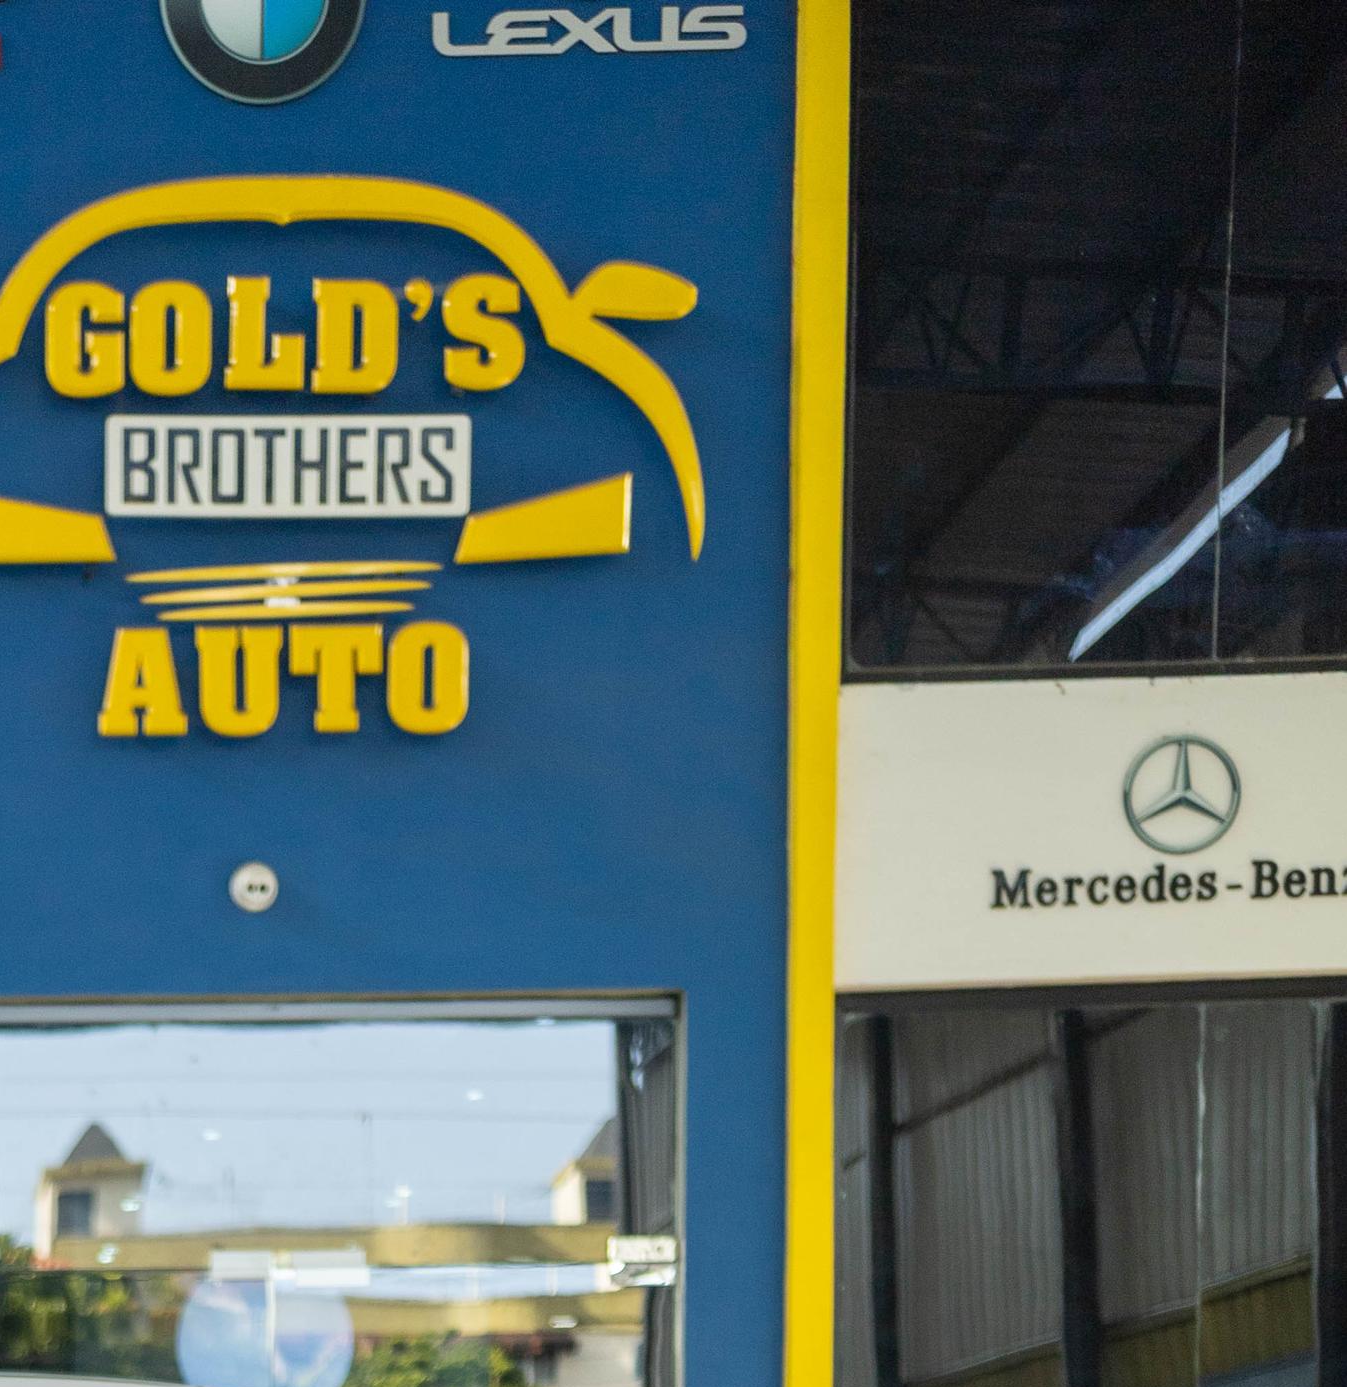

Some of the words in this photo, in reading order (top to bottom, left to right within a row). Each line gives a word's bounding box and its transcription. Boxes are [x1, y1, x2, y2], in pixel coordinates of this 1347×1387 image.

[432, 5, 748, 58] LEXUS
[43, 273, 526, 398] GOLD'S
[121, 425, 456, 506] BROTHERS
[97, 621, 470, 738] AUTO
[990, 858, 1347, 909] Mercedes-Ben
